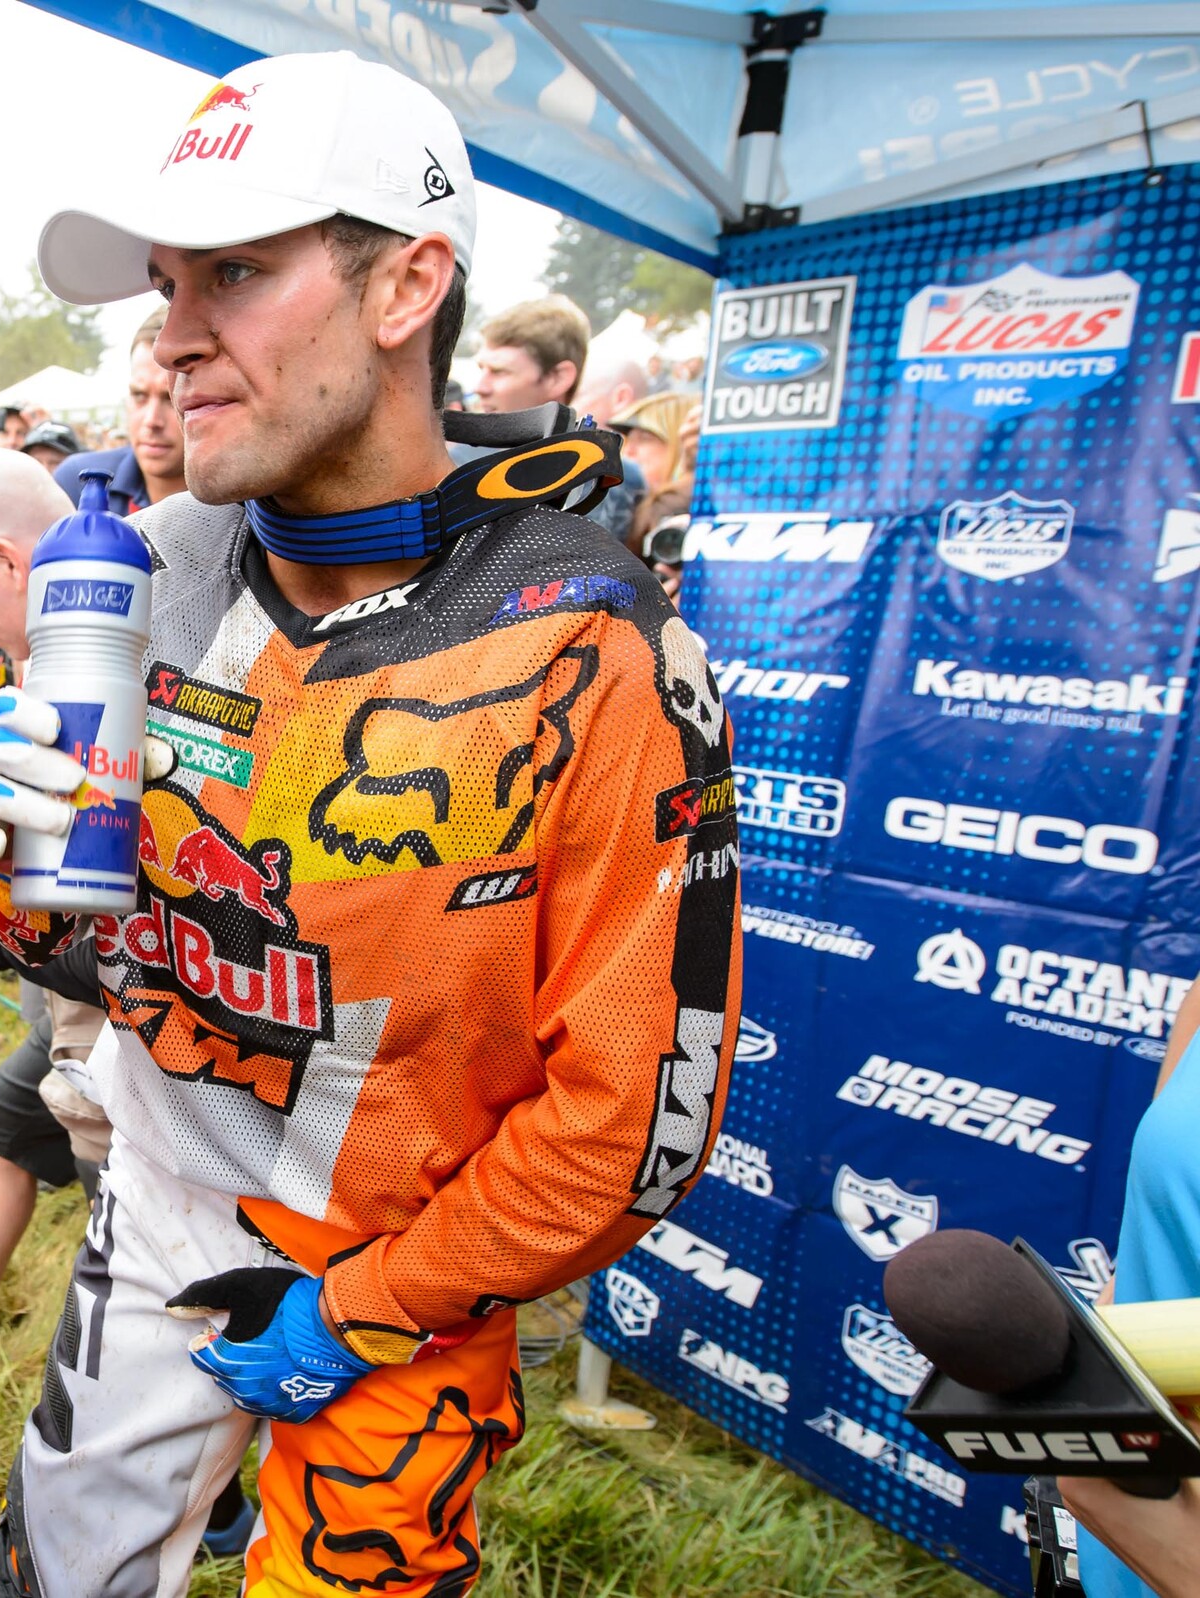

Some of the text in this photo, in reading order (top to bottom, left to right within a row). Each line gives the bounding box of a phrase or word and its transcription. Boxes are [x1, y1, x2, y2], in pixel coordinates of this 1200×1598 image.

[173, 122, 253, 163] Bull
[720, 288, 843, 342] BUILT
[919, 307, 1124, 354] LUCAS
[742, 347, 802, 375] Ford
[903, 355, 1117, 383] OIL PRODUCTS
[713, 381, 830, 421] TOUGH
[680, 511, 874, 562] KTM
[952, 519, 1065, 541] LUCAS
[46, 581, 134, 611] DUNGEY
[312, 583, 420, 632] FOX
[709, 659, 851, 702] thor
[912, 658, 1188, 716] Kawasaki
[940, 697, 971, 718] Let
[972, 701, 1003, 720] the
[1002, 706, 1049, 726] good
[1049, 708, 1105, 730] times
[88, 743, 139, 783] Bull
[89, 812, 131, 830] DRINK
[883, 796, 1160, 876] GEICO
[741, 914, 877, 962] PERSTORE!
[1005, 1010, 1095, 1042] FOUNDED
[1093, 1030, 1124, 1047] BY
[858, 1055, 1057, 1127] MOOSE
[875, 1086, 1093, 1165] RACING
[846, 1181, 927, 1217] RACER
[859, 1203, 903, 1247] X
[943, 1431, 1150, 1463] FUEL
